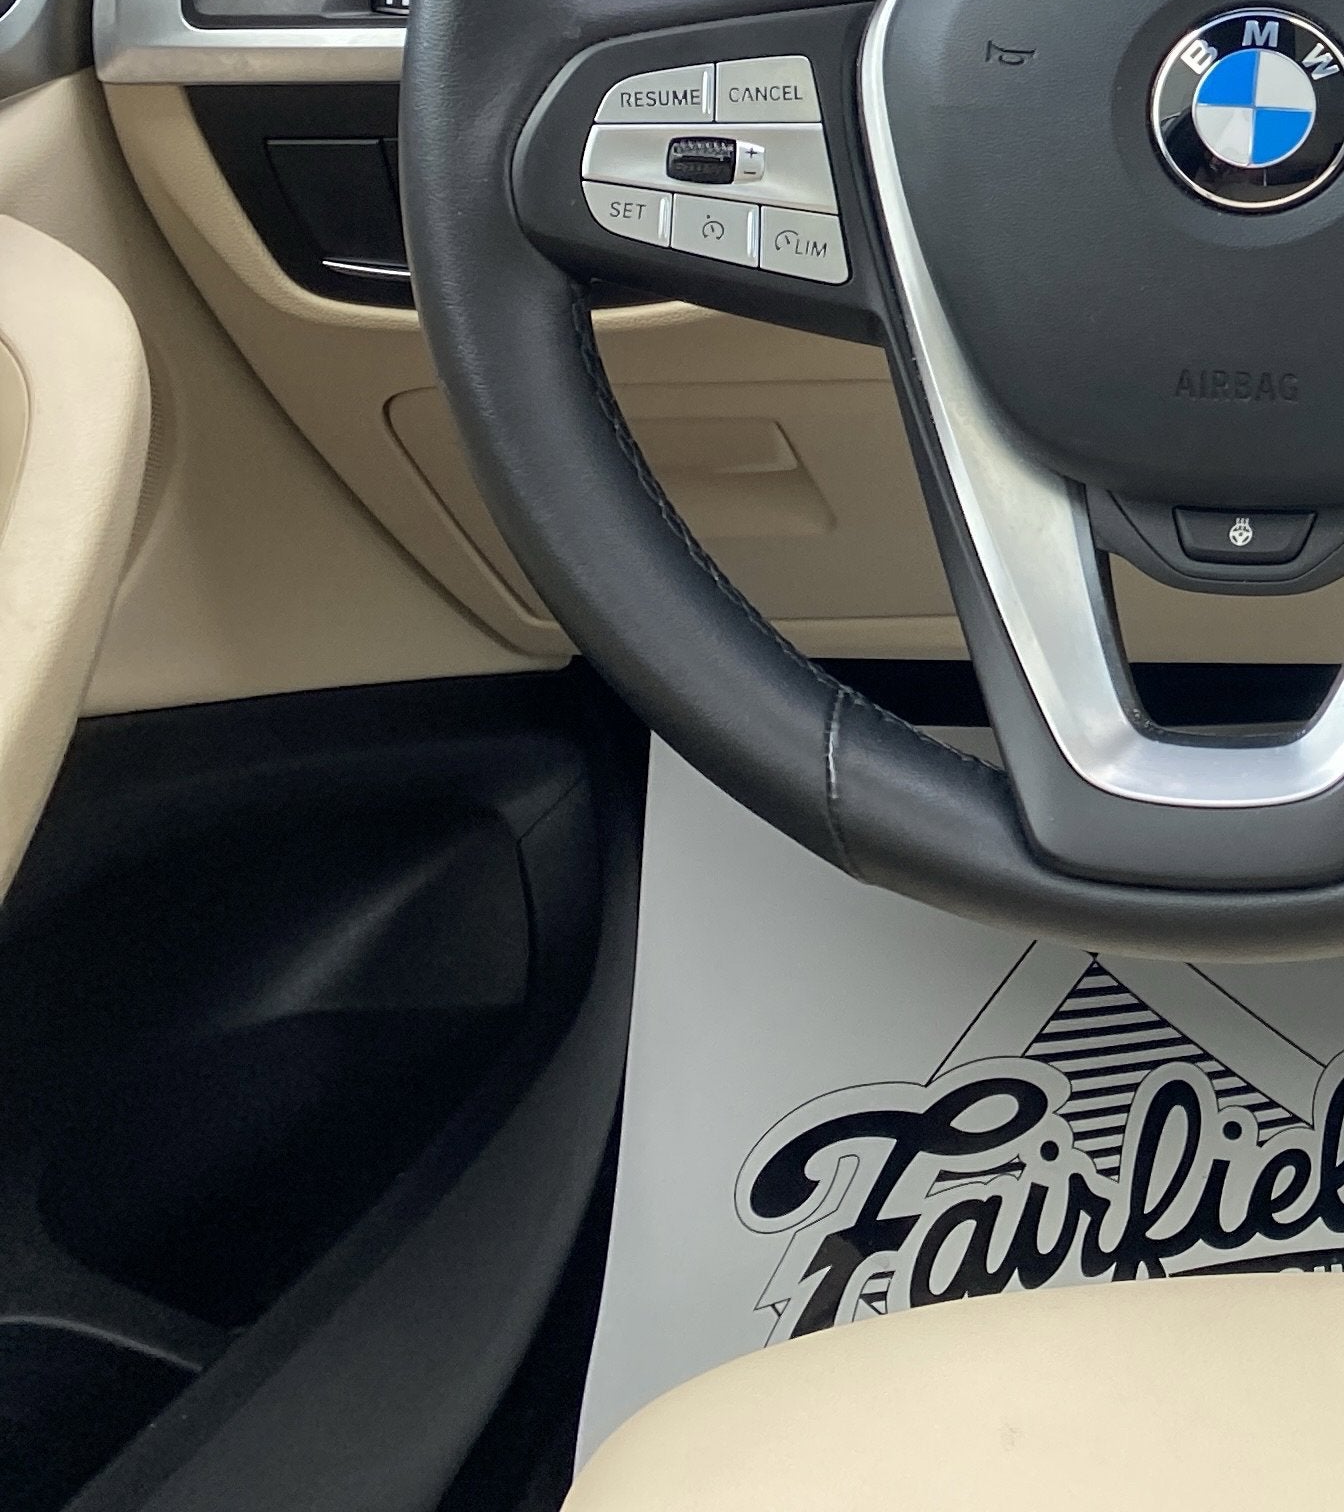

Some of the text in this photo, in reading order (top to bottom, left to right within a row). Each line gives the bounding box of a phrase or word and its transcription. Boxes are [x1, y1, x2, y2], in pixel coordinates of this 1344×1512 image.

[1179, 18, 1343, 82] BMW
[618, 87, 701, 109] RESUME
[728, 83, 804, 105] CANCEL
[608, 199, 647, 221] SET
[794, 238, 829, 260] LIM
[1174, 368, 1301, 403] AIRBAG
